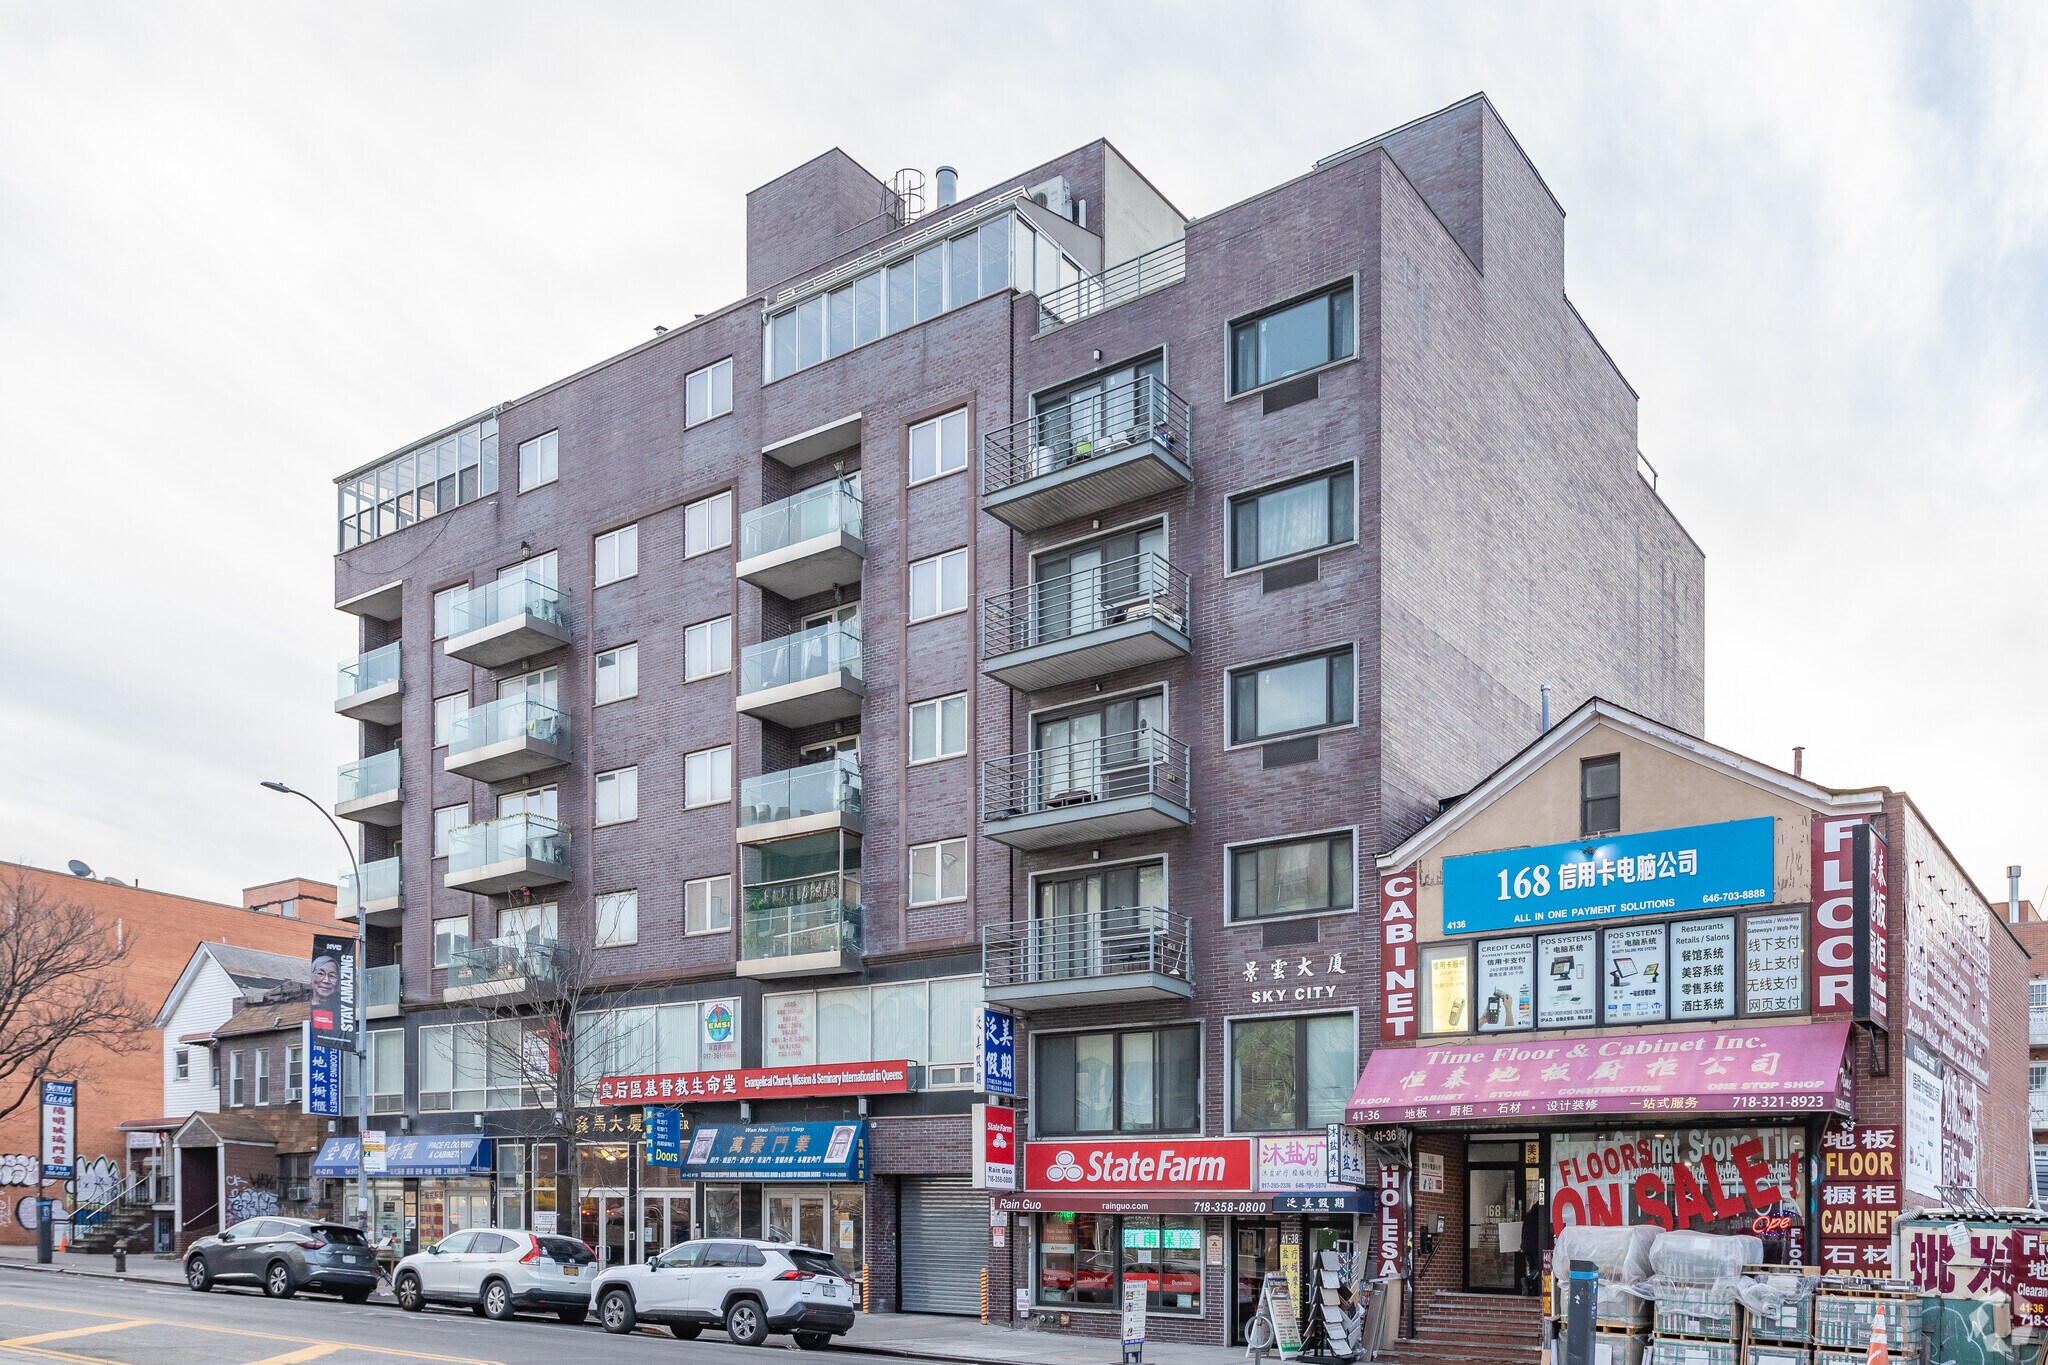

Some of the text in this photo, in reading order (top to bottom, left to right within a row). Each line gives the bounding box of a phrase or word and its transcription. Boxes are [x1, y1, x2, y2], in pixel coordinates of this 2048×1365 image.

[1497, 848, 1698, 902] 168 信用卡电脑公司
[1702, 888, 1766, 905] 646-703-8888
[1514, 898, 1675, 923] ALL IN ONE PAYMENT SOLUTIONS
[1777, 915, 1800, 923] Wireless
[1816, 818, 1862, 1007] FLOOR
[1447, 920, 1467, 930] 4136
[1681, 923, 1724, 933] Restaurants
[1540, 935, 1593, 945] POS SYSTEMS
[1608, 928, 1663, 940] POS SYSTEMS
[1624, 937, 1657, 947] 电脑系统
[1675, 936, 1700, 945] Retails
[1705, 933, 1730, 942] Salons
[327, 943, 342, 951] NYC
[1553, 945, 1584, 953] 电脑系统
[1748, 935, 1800, 952] 线下支付
[1383, 876, 1415, 1037] CABINET
[1487, 957, 1526, 965] 信用卡支付
[1681, 947, 1724, 962] 餐馆系统
[1681, 964, 1724, 978] 美容系统
[1748, 955, 1800, 972] 线上支付
[1681, 980, 1724, 995] 零售系统
[1748, 975, 1800, 992] 无线支付
[341, 954, 354, 1032] STAY AMAZING
[1252, 985, 1337, 1003] SKY CITY
[1681, 998, 1724, 1012] 酒庄系统
[1748, 995, 1800, 1012] 网页支付
[708, 1021, 731, 1029] EMSI
[986, 1016, 1013, 1047] 泛美
[1427, 1035, 1767, 1066] Time Floor & Cabinet Inc.
[329, 1048, 338, 1078] FLOORING
[986, 1051, 1012, 1079] 假期
[1400, 1052, 1781, 1090] 恒泰地板厨柜公司
[45, 1082, 73, 1094] SUNLIT
[600, 1074, 737, 1100] 皇后區基督教生命堂
[744, 1069, 903, 1090] Evangelical Church, Mission & Seminary International in Queens
[45, 1093, 72, 1104] GLASS
[329, 1084, 338, 1113] CABINETS
[1354, 1080, 1825, 1105] FLOOR CABINET STONE CONSTRUCTION ONE STOP SHOP
[1405, 1097, 1699, 1119] 地板 厨柜 石材 设计装修 一站式服务
[1732, 1095, 1824, 1108] 718-321-8923
[1352, 1110, 1380, 1121] 41-36
[444, 1140, 474, 1149] FLOORING
[729, 1135, 811, 1154] 萬豪門業
[1374, 1130, 1397, 1142] 41-36
[1757, 1127, 1805, 1160] Tile
[1823, 1130, 1897, 1149] 地板
[428, 1150, 433, 1159] &
[656, 1149, 678, 1162] Doors
[1558, 1138, 1652, 1187] FLOORS
[1001, 1167, 1012, 1175] Guo
[1825, 1151, 1894, 1176] FLOOR
[1552, 1138, 1799, 1238] ON SALE!
[1823, 1185, 1897, 1205] 橱柜
[999, 1198, 1042, 1210] Rain Guo
[1102, 1202, 1149, 1212] rainguo.com
[1193, 1202, 1266, 1213] 718-358-0800
[1286, 1197, 1345, 1209] 泛美假期
[1486, 1205, 1501, 1217] 168
[1378, 1164, 1400, 1277] HOLESA
[1821, 1210, 1899, 1234] CABINET
[1125, 1231, 1194, 1248] 红雨保险
[1282, 1234, 1299, 1244] 41-38
[1824, 1244, 1891, 1265] 石材
[2019, 1303, 2044, 1314] 41-36
